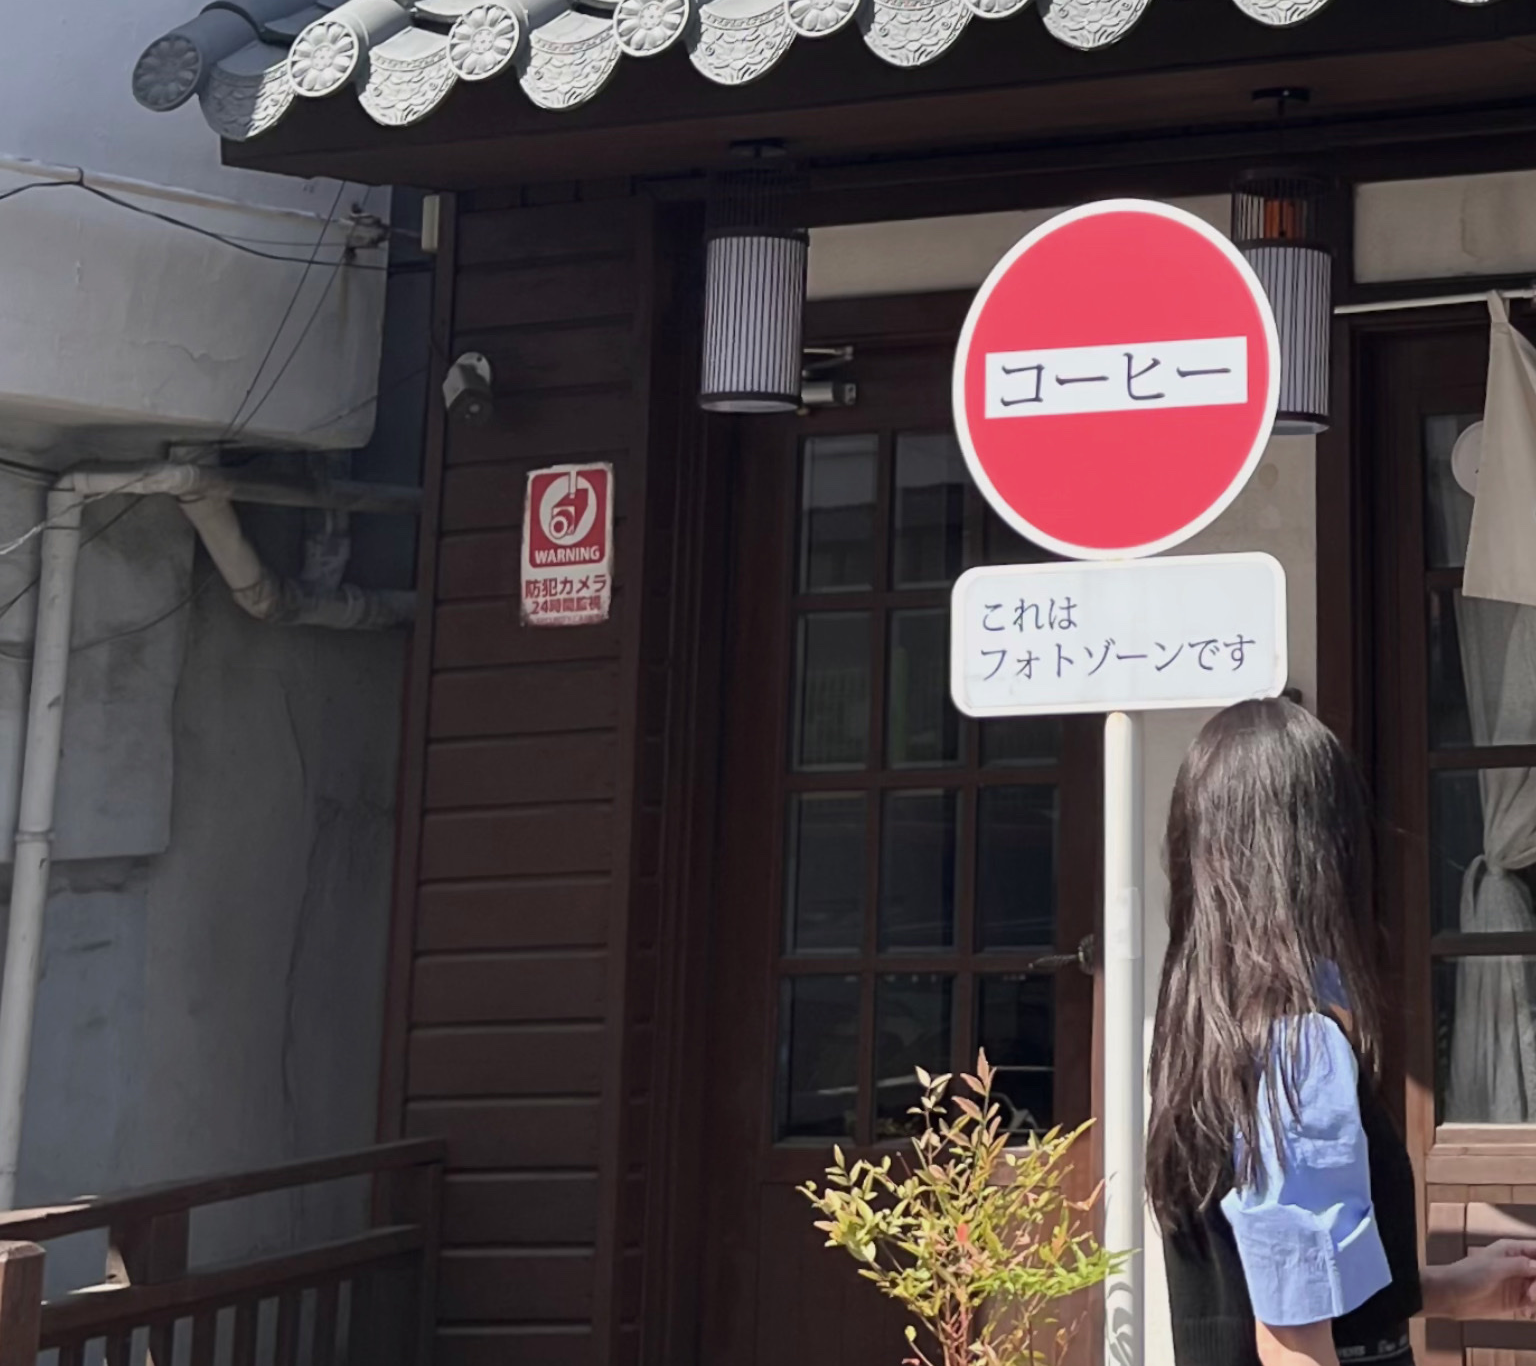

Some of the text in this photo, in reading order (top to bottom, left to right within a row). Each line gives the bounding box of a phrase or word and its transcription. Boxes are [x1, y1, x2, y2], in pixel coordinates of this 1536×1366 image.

[1000, 352, 1232, 407] コーヒー
[535, 546, 600, 565] WARNING
[525, 574, 607, 598] 防犯カメラ
[981, 597, 1078, 633] これは
[981, 634, 1256, 682] フォトゾーンです
